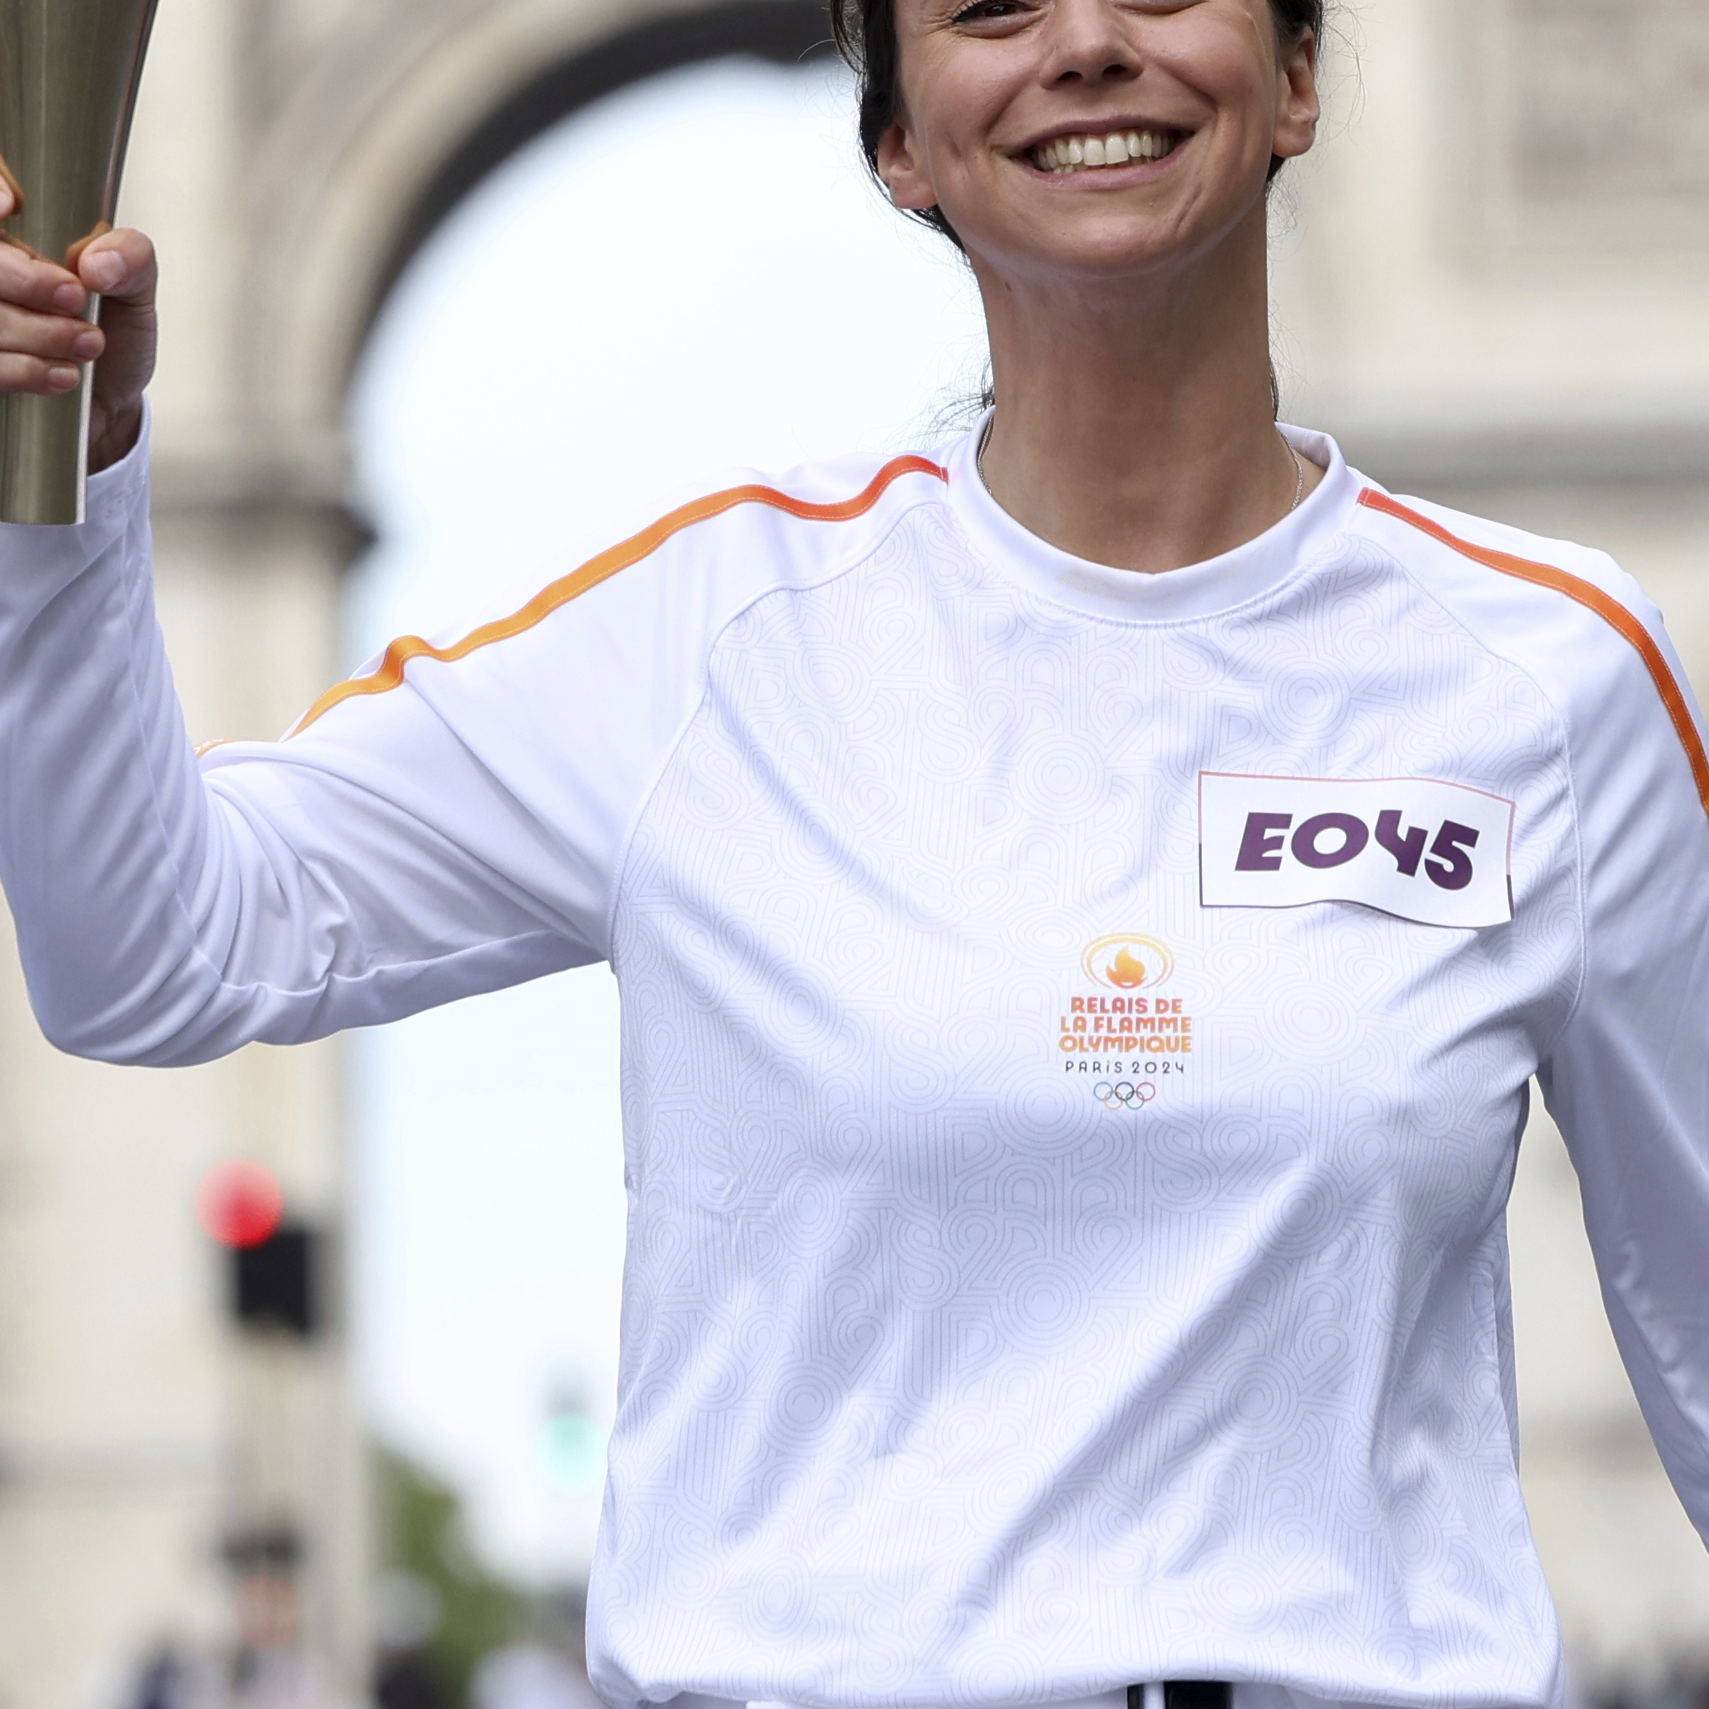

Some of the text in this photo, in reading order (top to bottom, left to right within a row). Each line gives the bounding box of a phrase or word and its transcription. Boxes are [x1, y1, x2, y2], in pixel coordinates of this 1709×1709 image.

[1070, 996, 1183, 1014] RELAIS DE
[1060, 1016, 1192, 1034] LA FLAMME
[1058, 1035, 1192, 1054] OLYMPIQUE
[1131, 1061, 1185, 1074] 2024
